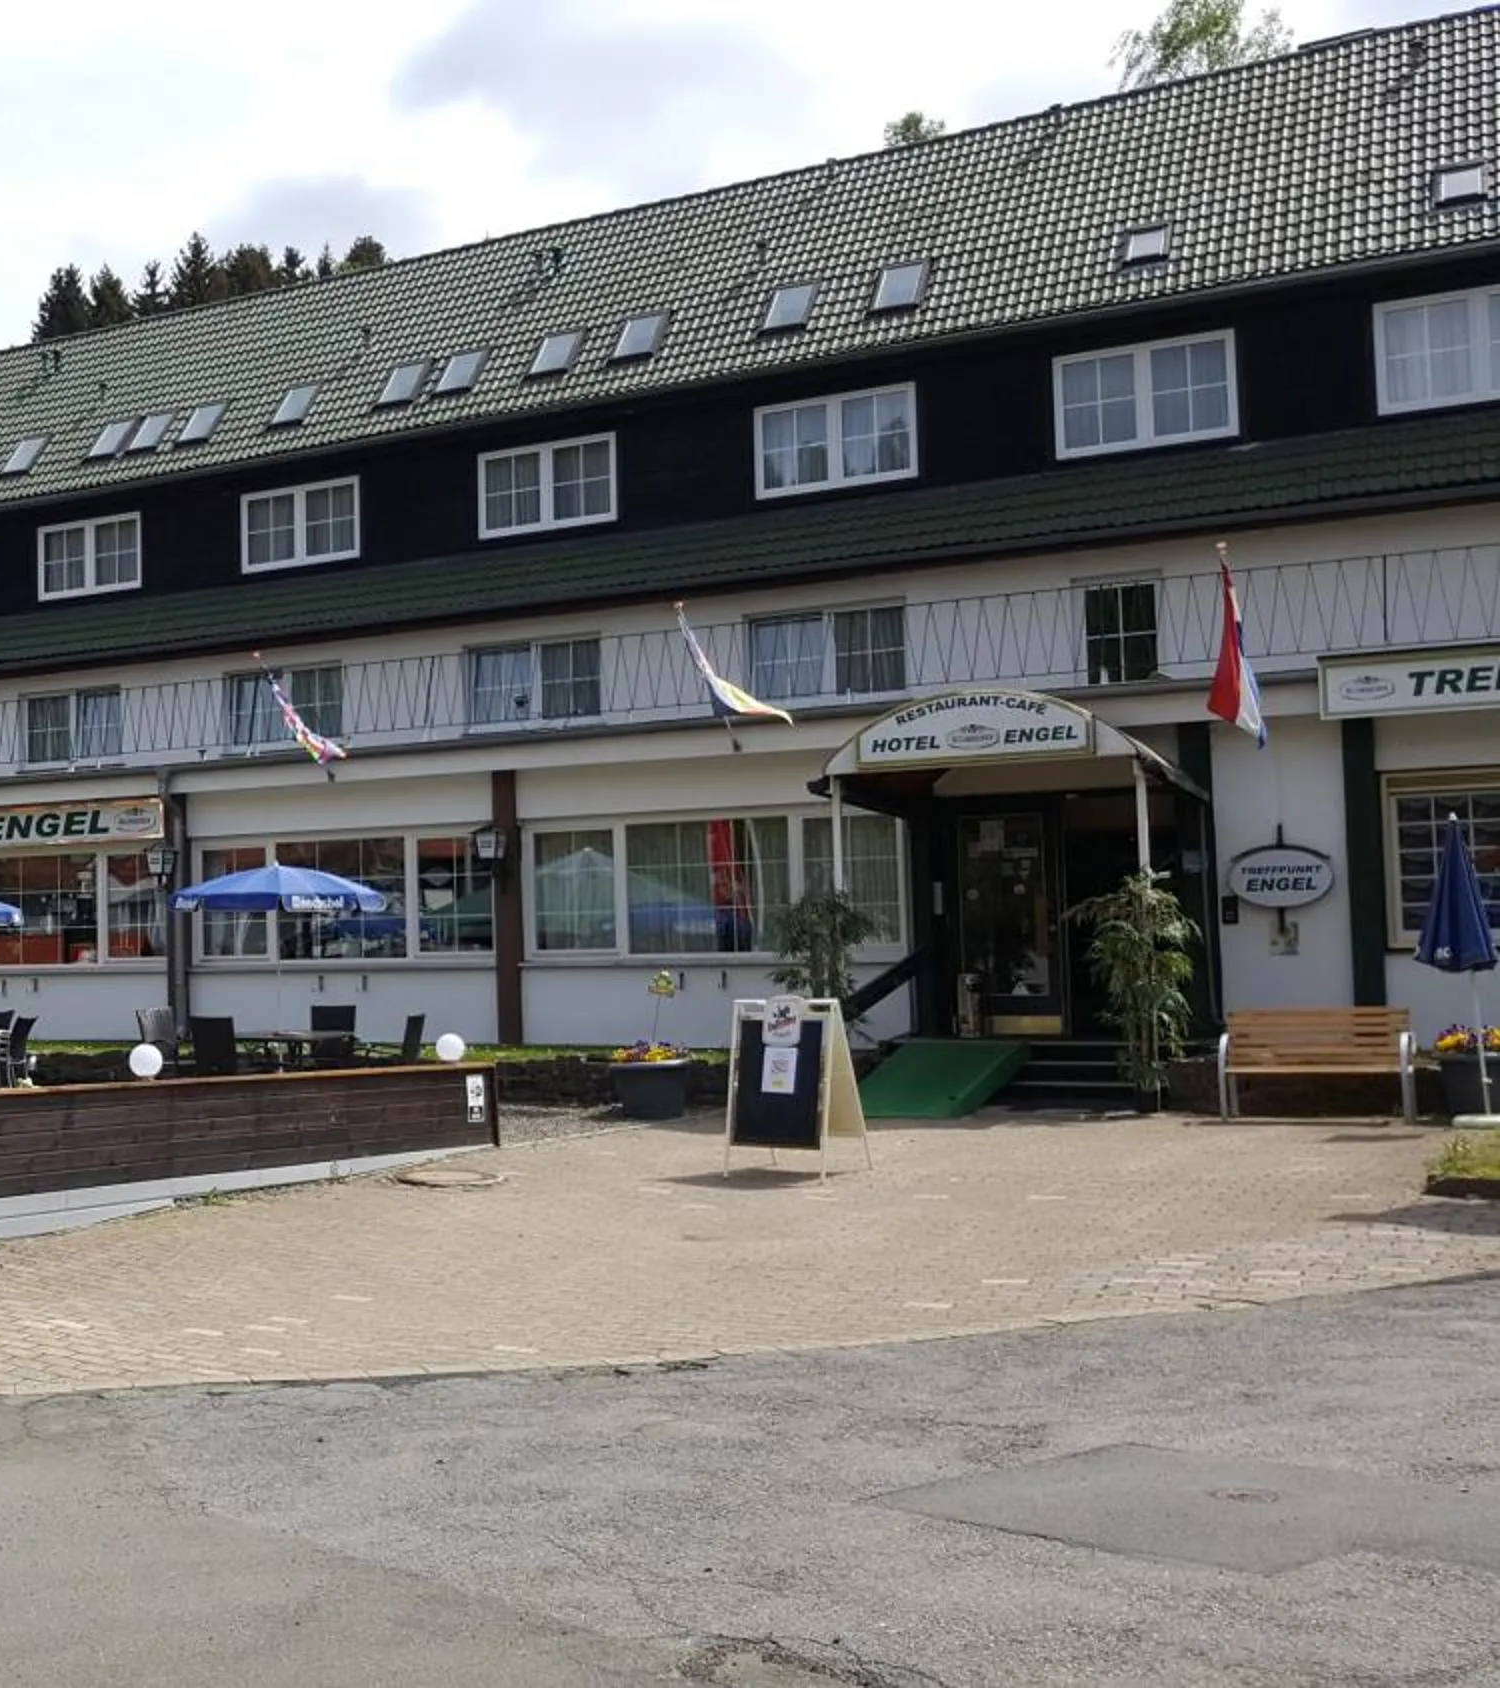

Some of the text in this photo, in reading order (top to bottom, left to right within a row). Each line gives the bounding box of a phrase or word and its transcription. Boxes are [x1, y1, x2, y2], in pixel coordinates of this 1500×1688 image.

[1408, 665, 1500, 697] TRE
[871, 735, 941, 753] HOTEL
[1003, 725, 1079, 744] ENGEL
[1240, 864, 1323, 875] TREFFPUNKT
[1246, 877, 1317, 892] ENGEL
